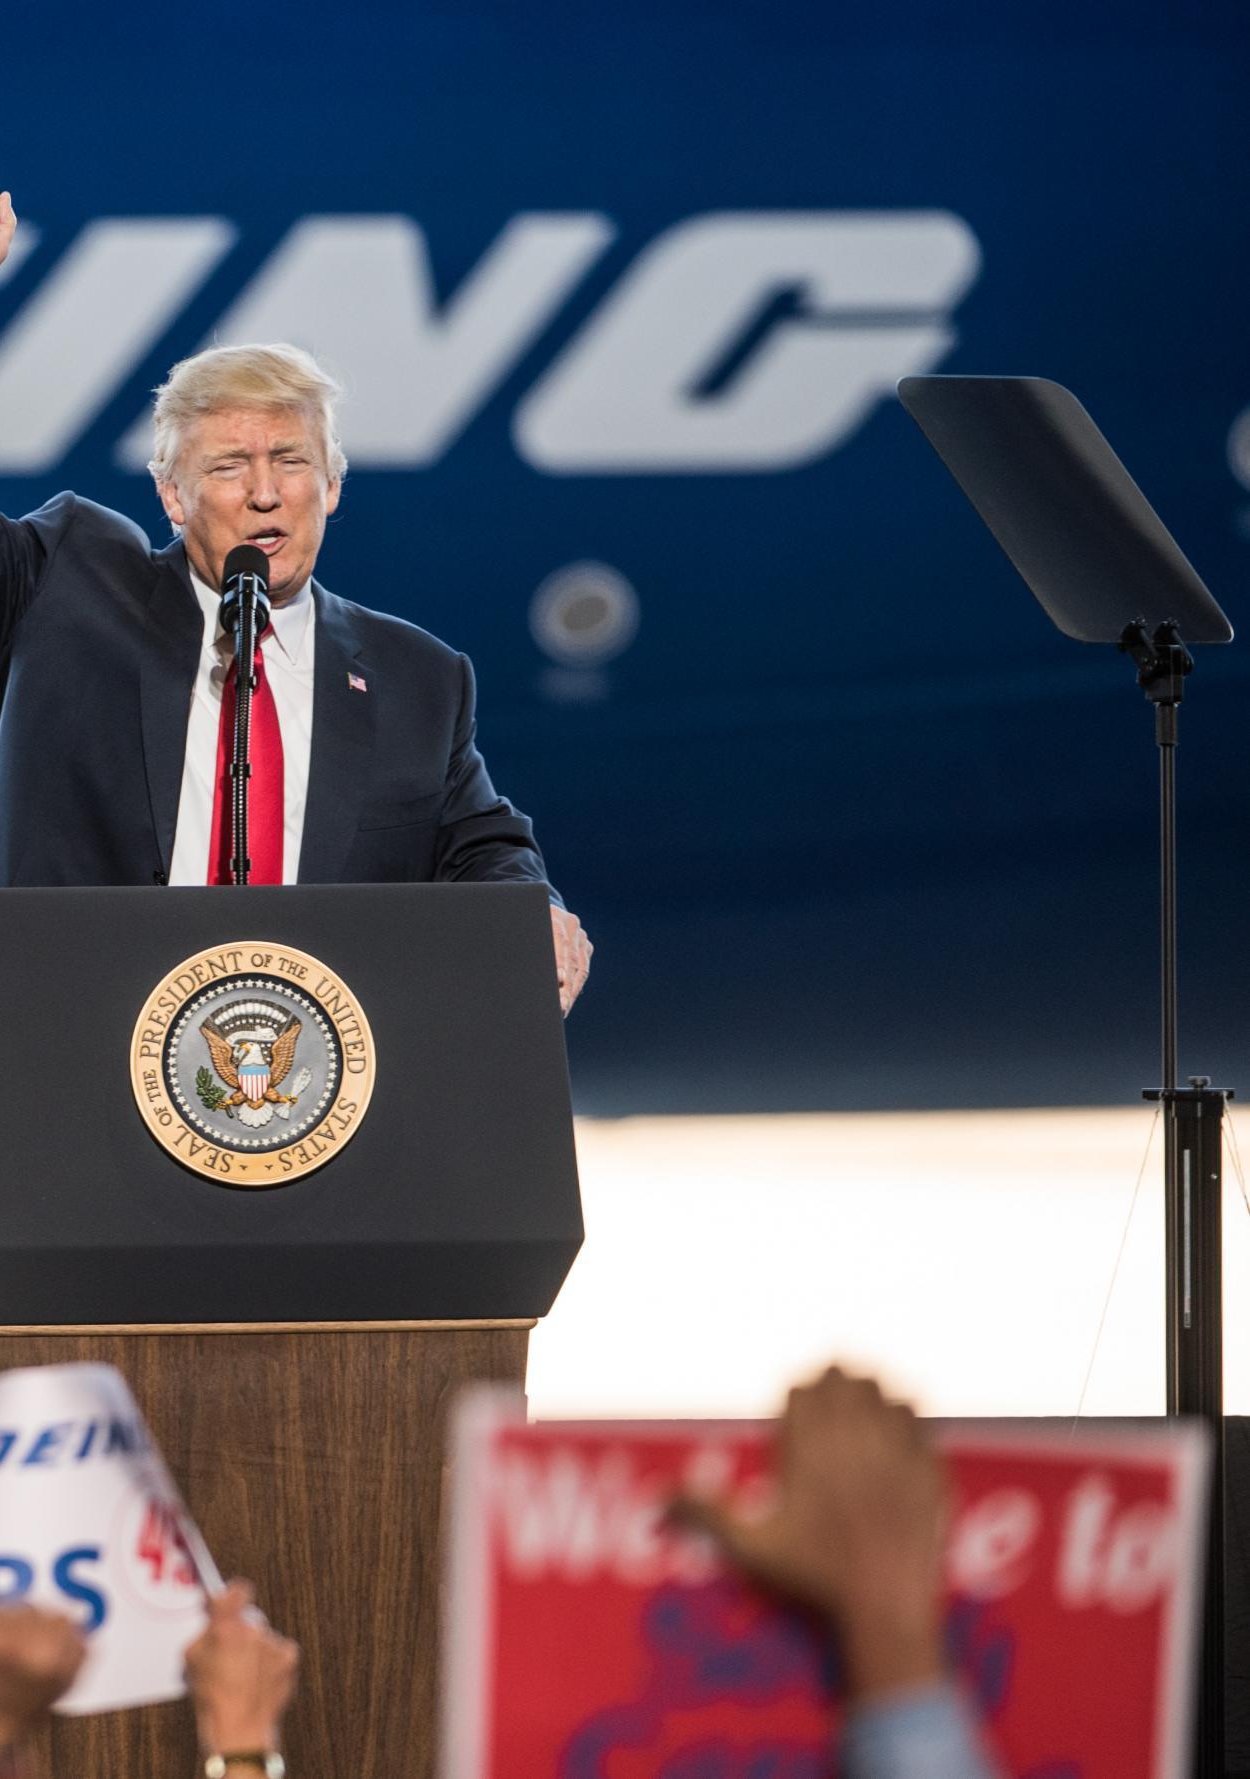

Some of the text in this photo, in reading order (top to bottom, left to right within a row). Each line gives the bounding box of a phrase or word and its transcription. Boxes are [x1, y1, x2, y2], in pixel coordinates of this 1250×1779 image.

[140, 951, 367, 1173] SEAL OF THE PRESIDENT OF THE UNITED STATES
